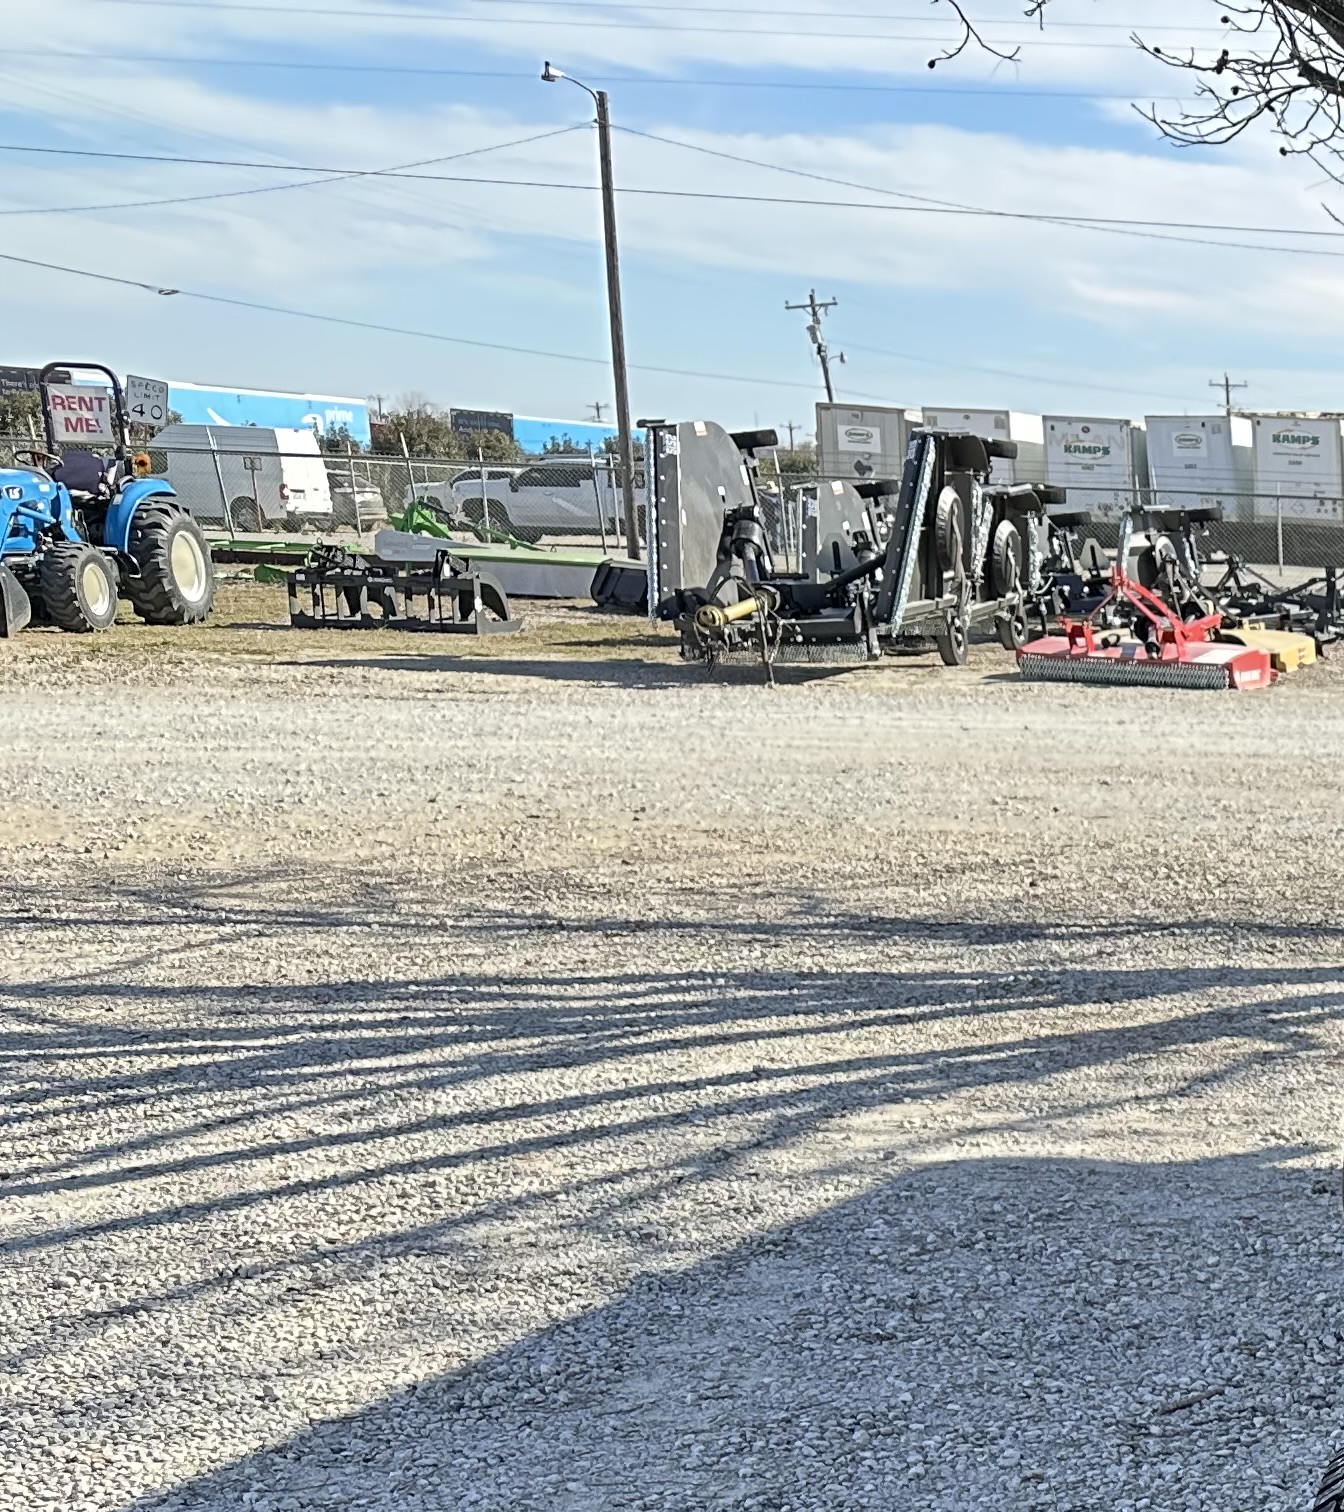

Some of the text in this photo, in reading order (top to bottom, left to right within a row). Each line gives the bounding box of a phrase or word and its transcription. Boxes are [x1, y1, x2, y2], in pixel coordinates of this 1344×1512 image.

[51, 394, 107, 412] RENT
[325, 406, 353, 424] prime
[64, 416, 104, 434] ME!
[1272, 433, 1321, 446] KAMPS
[1064, 444, 1111, 456] KAMPS
